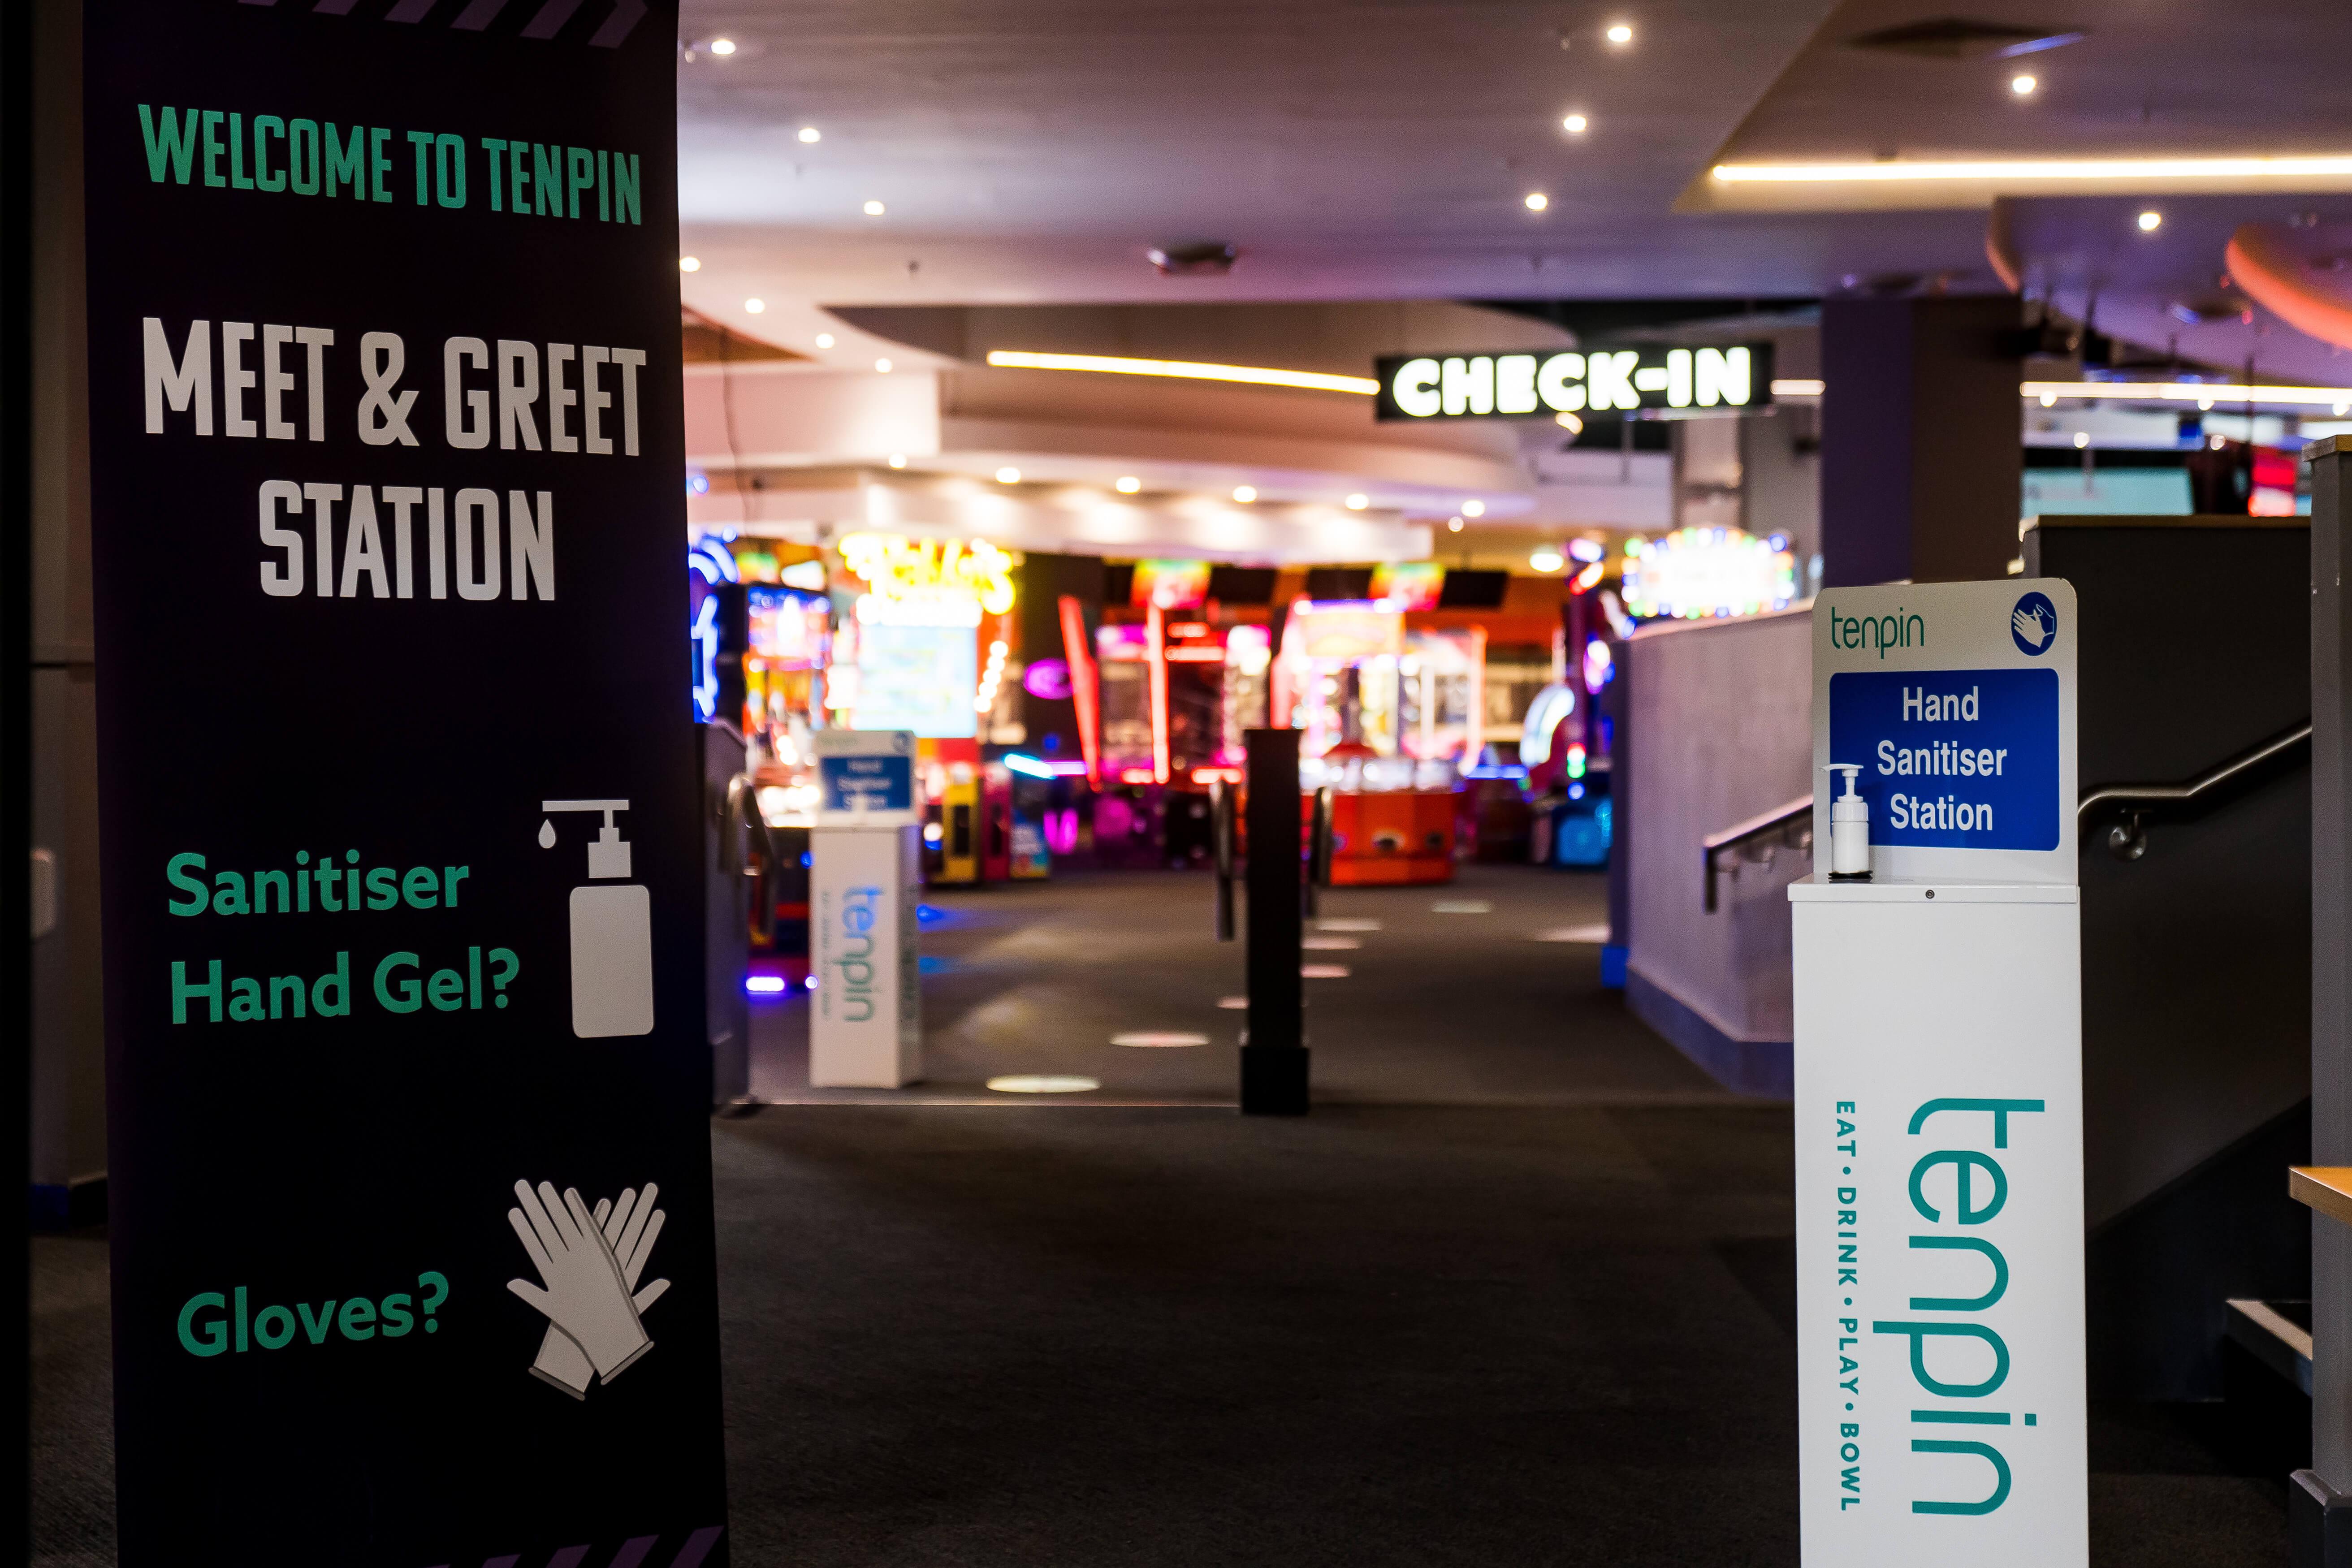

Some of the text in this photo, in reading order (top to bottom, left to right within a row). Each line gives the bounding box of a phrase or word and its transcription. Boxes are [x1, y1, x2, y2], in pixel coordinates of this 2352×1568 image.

[138, 104, 641, 225] WELCOME TO TENPIN
[143, 317, 646, 456] MEET & GREET
[1392, 347, 1751, 417] CHECK-IN
[259, 480, 555, 601] STATION
[1830, 606, 1924, 659] tenpin
[1903, 686, 1979, 721] Hand
[1877, 740, 2007, 776] Sanitiser
[1890, 793, 1993, 831] Station
[167, 849, 469, 916] Sanitiser
[171, 946, 519, 1024] Hand Gel?
[832, 886, 883, 1022] tenpin
[177, 1271, 449, 1357] Gloves?
[1836, 1101, 1860, 1511] EAT DRINK PLAY BOWL
[1872, 1098, 2045, 1516] tenpin
